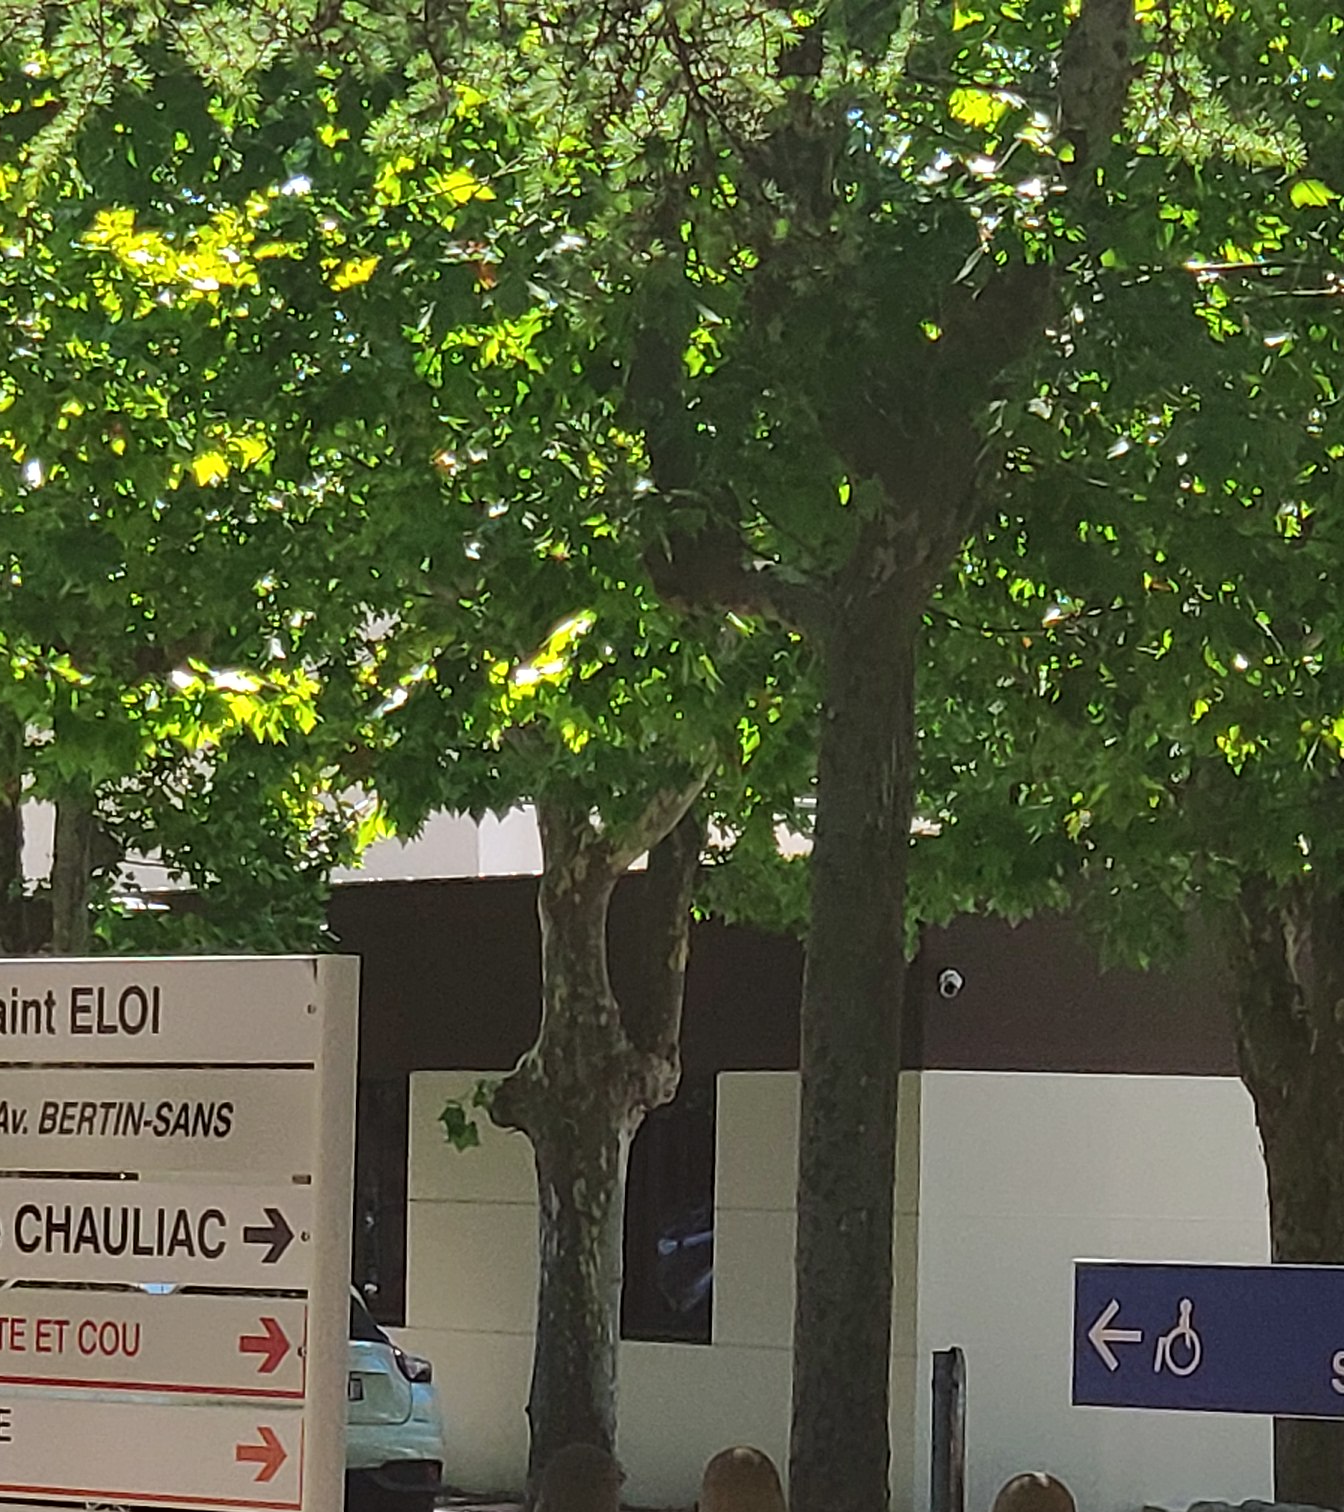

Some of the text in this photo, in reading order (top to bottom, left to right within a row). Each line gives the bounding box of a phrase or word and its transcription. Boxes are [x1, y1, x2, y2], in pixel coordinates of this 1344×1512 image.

[70, 985, 160, 1035] ELOI
[38, 1101, 234, 1137] BERTIN-SANS
[14, 1204, 226, 1259] CHAULIAC
[35, 1319, 70, 1353] ET
[78, 1320, 140, 1357] COU
